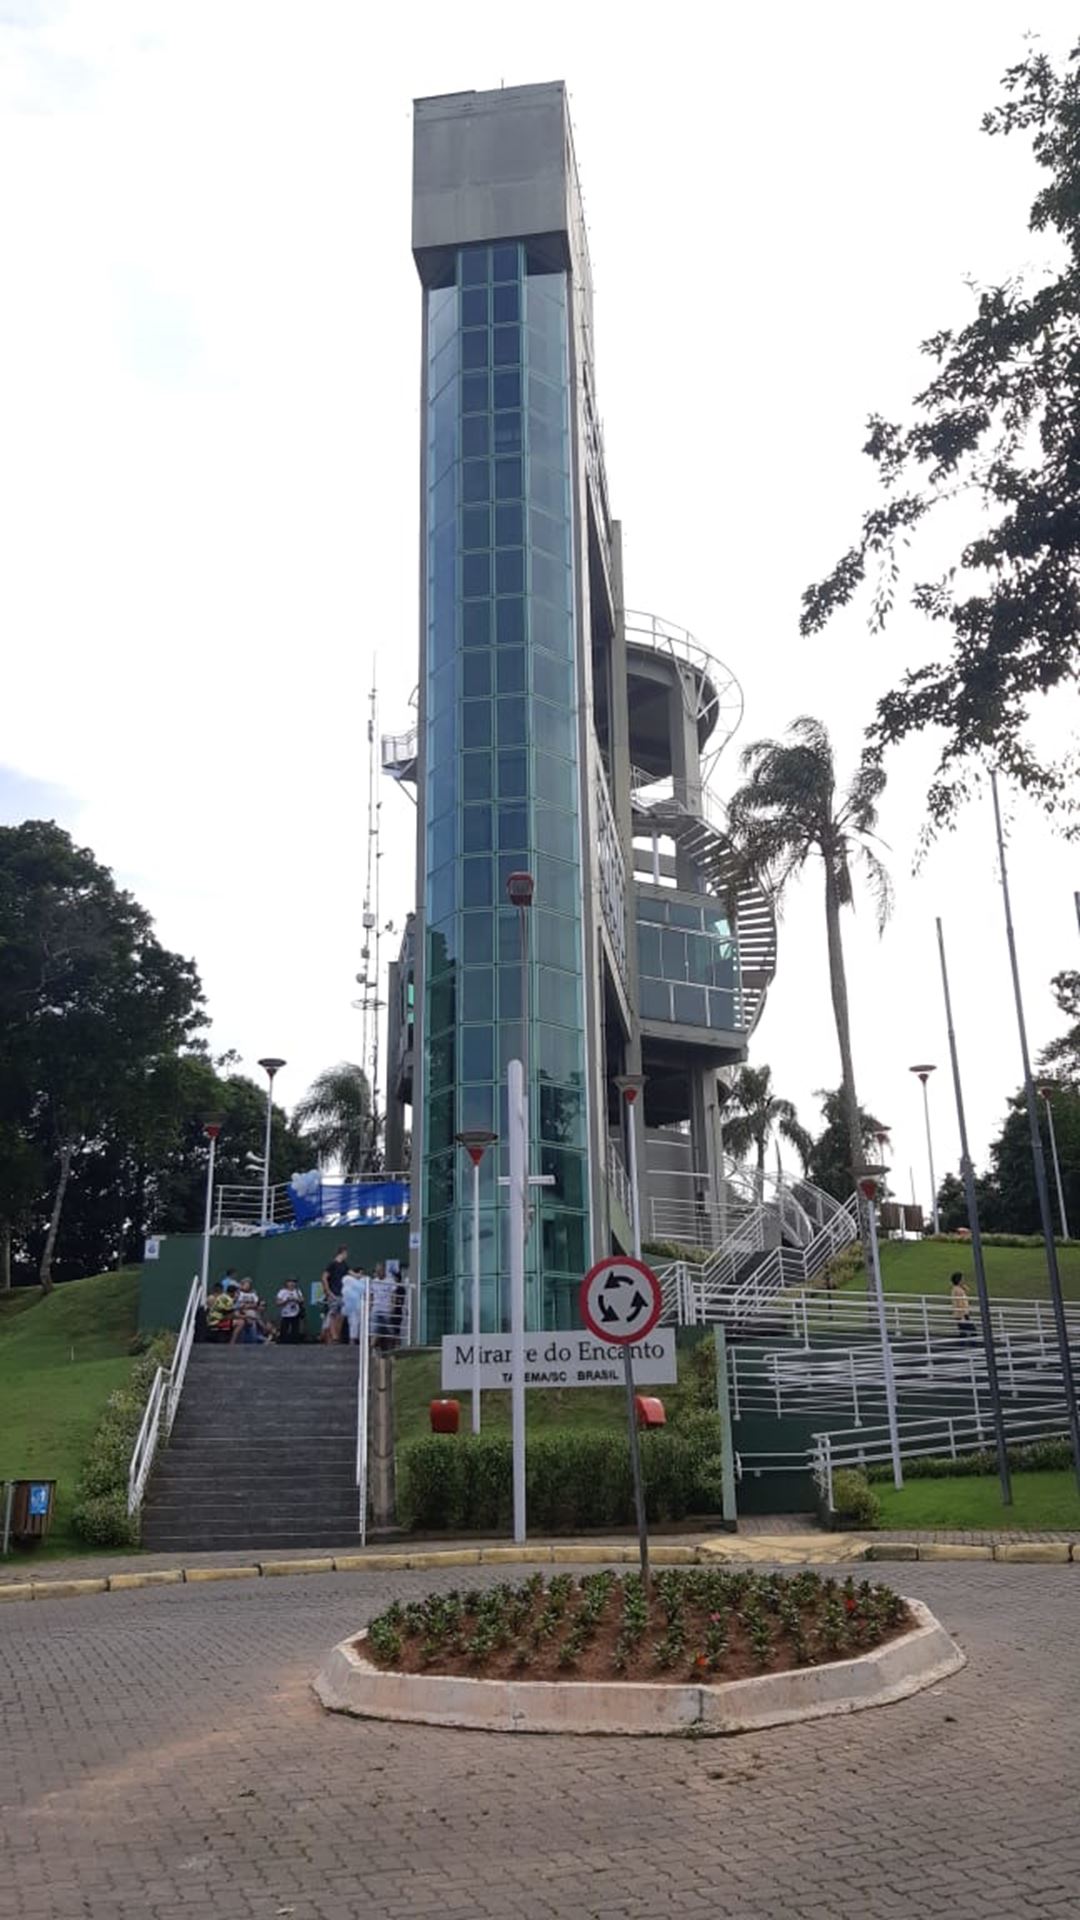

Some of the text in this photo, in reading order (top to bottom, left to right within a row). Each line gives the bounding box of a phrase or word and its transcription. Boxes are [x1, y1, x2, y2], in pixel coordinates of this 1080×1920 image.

[544, 1341, 572, 1362] do
[578, 1341, 664, 1361] Encanto
[577, 1369, 619, 1381] BRASIL
